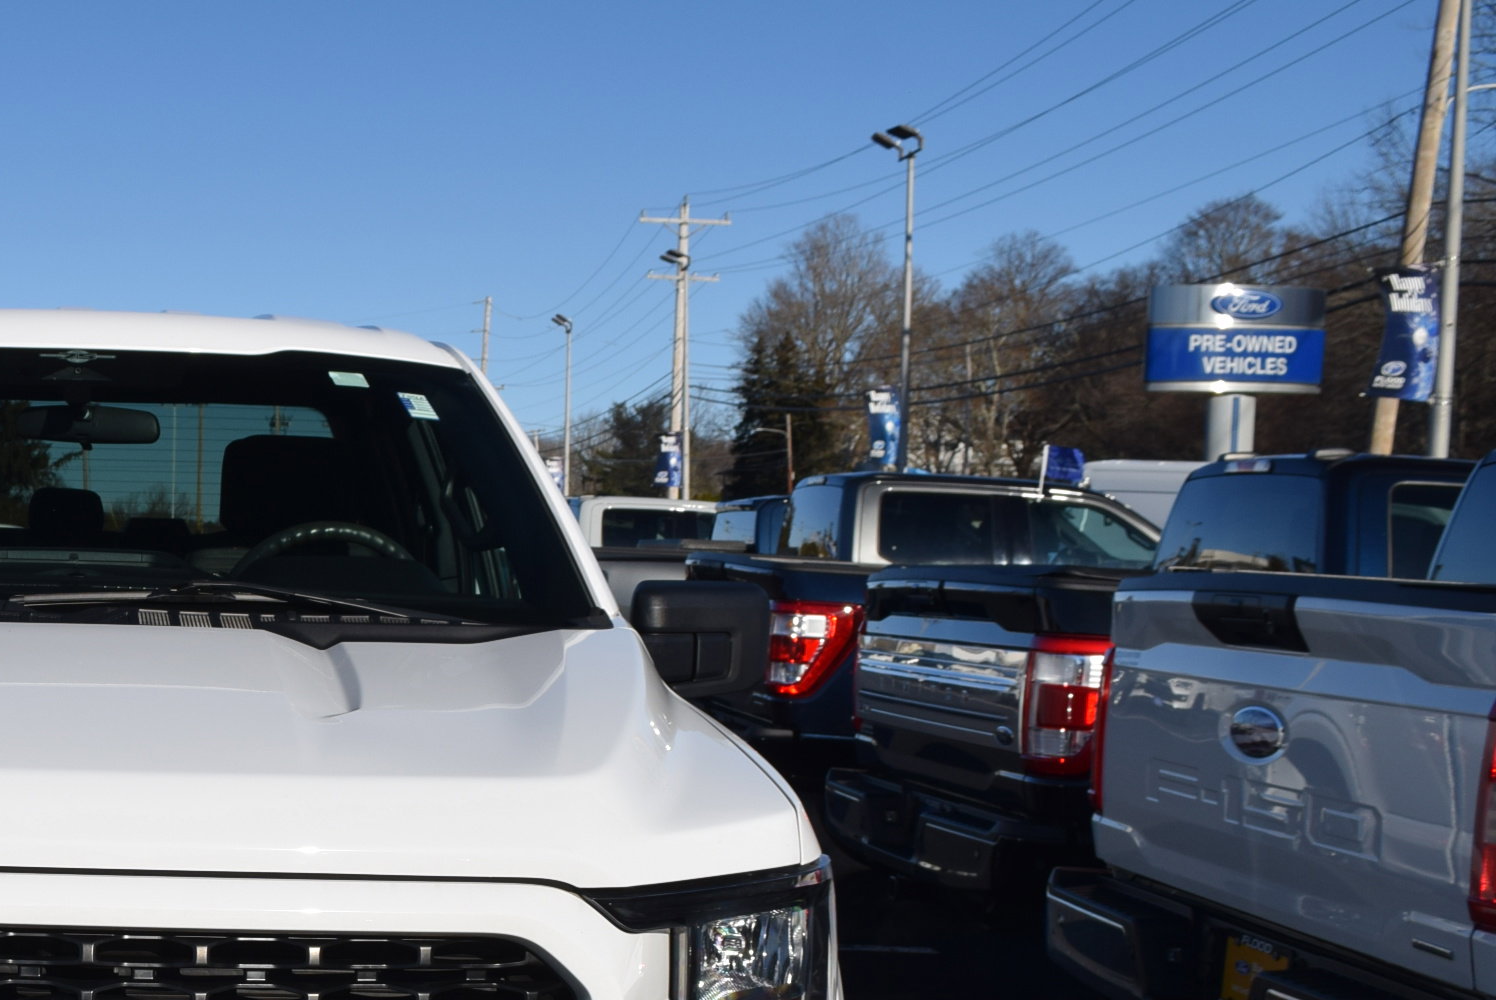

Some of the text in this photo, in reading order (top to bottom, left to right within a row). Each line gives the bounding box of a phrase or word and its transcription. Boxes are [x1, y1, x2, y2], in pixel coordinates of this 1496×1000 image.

[1227, 294, 1272, 313] Ford
[1188, 334, 1297, 354] PRE-OWNED
[1202, 356, 1287, 376] VEHICLES
